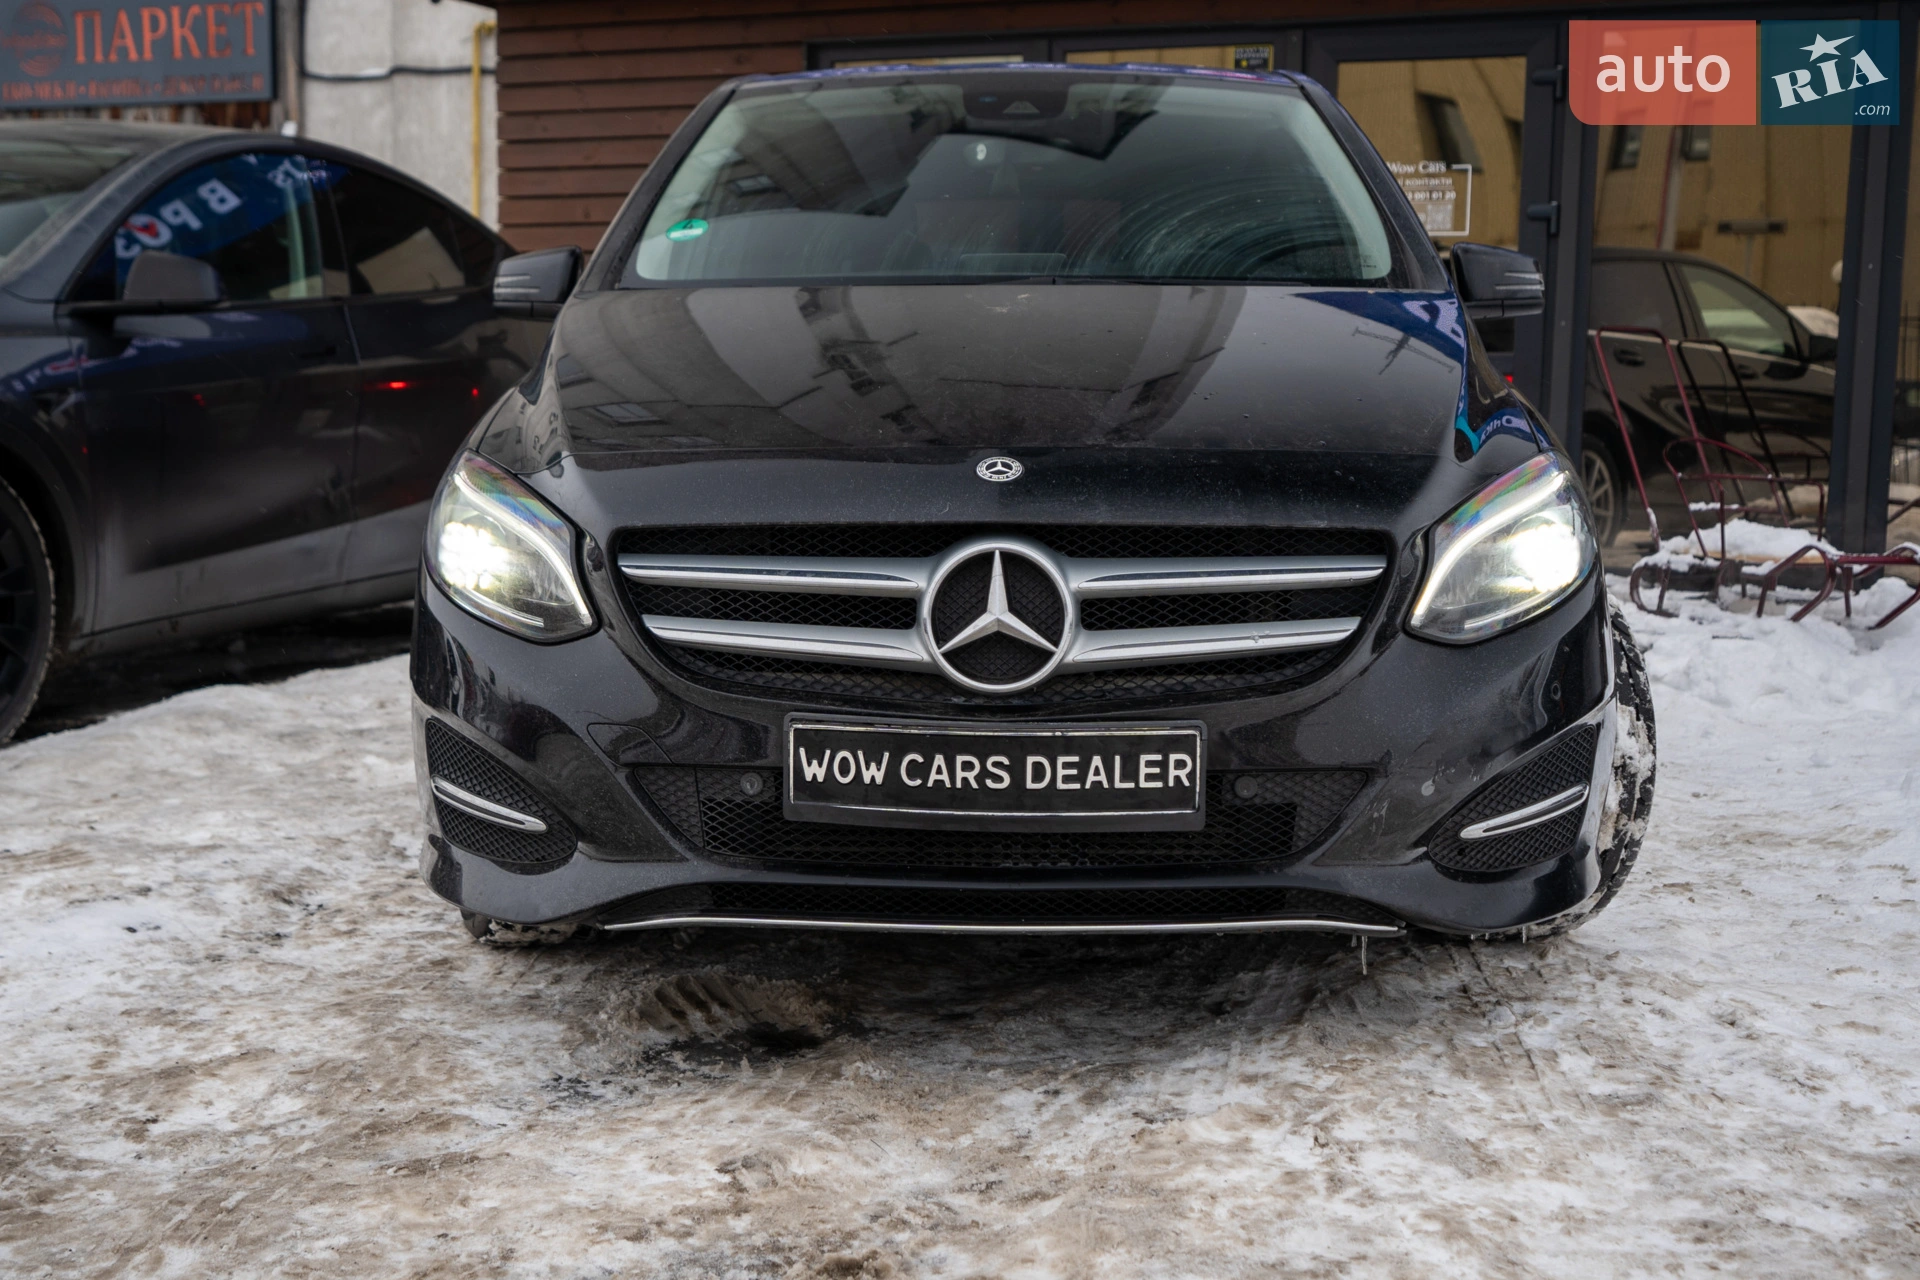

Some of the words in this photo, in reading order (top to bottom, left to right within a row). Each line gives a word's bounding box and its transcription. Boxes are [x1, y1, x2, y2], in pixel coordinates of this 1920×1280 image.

[73, 2, 266, 64] ПАРКЕТ
[799, 747, 890, 786] WOW
[900, 752, 1011, 789] CARS
[1025, 753, 1193, 790] DEALER
